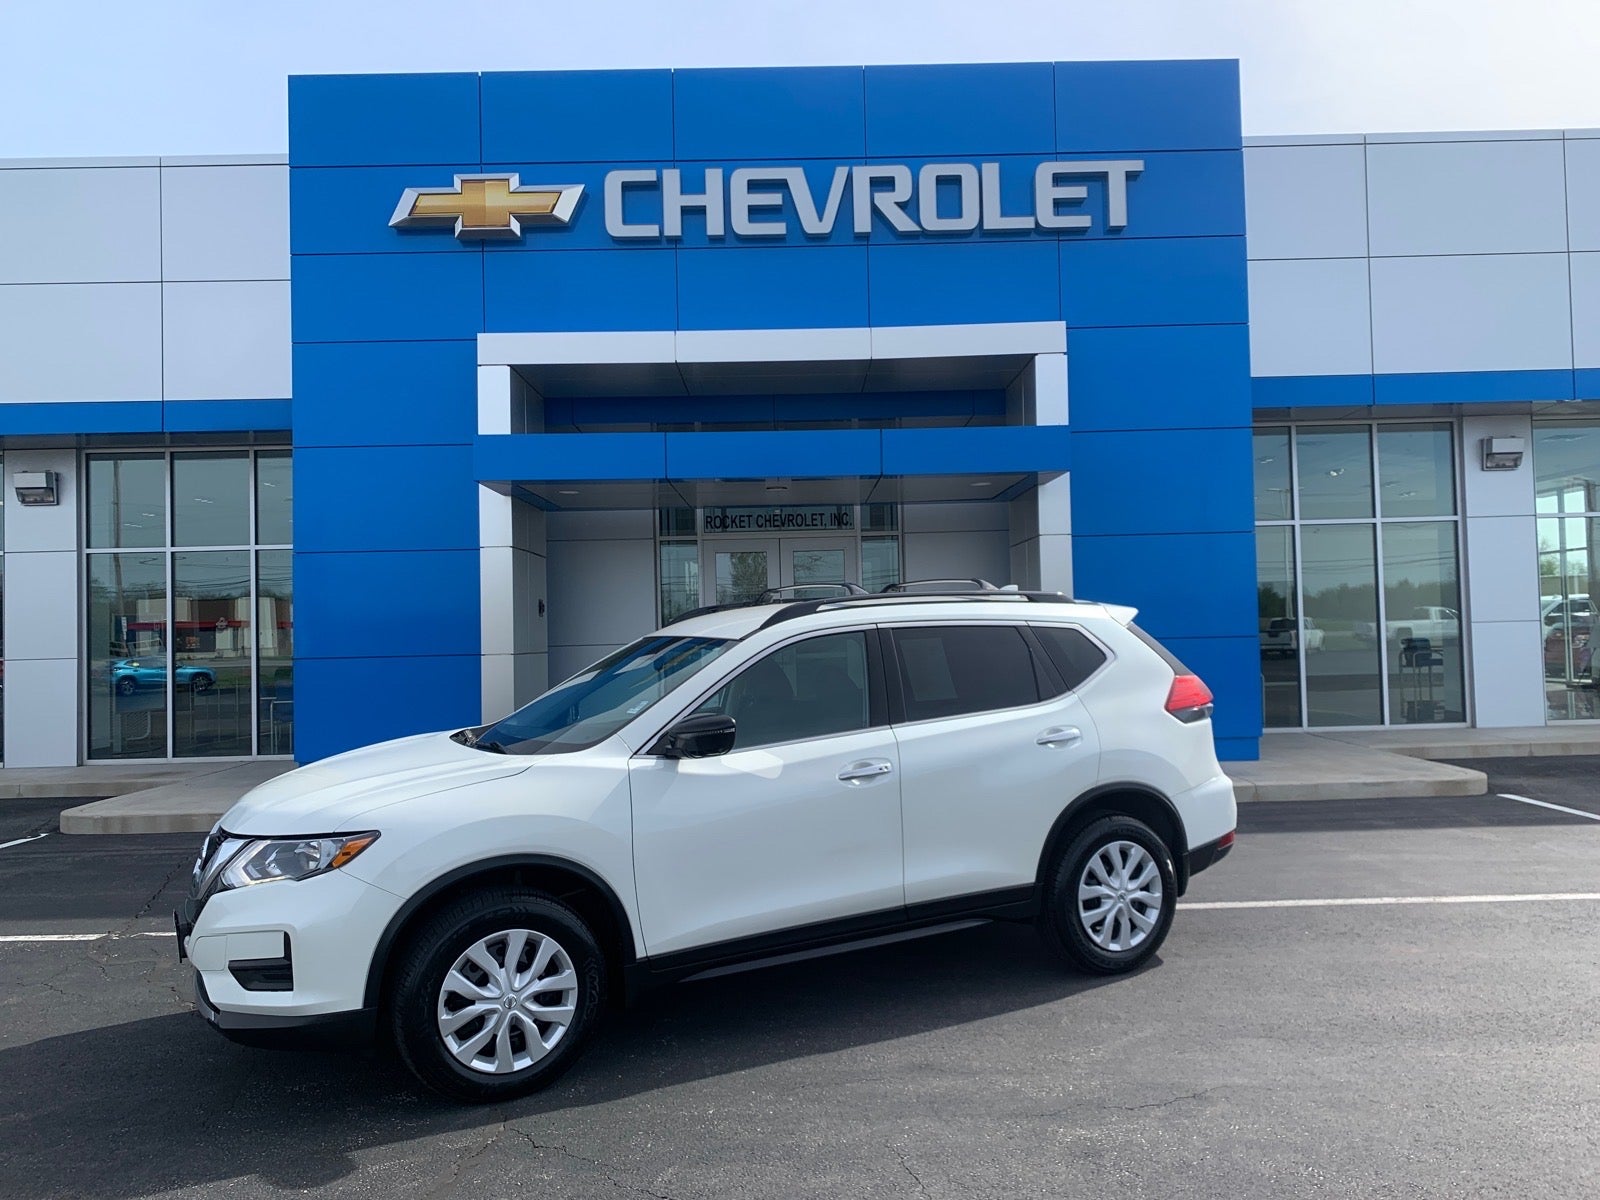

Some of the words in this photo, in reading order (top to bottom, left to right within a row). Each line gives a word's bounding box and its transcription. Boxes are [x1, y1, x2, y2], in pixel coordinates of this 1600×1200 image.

[604, 160, 1144, 237] CHEVROLET
[705, 514, 752, 529] ROCKET
[756, 512, 827, 528] CHEVROLET,
[830, 511, 853, 526] INC.
